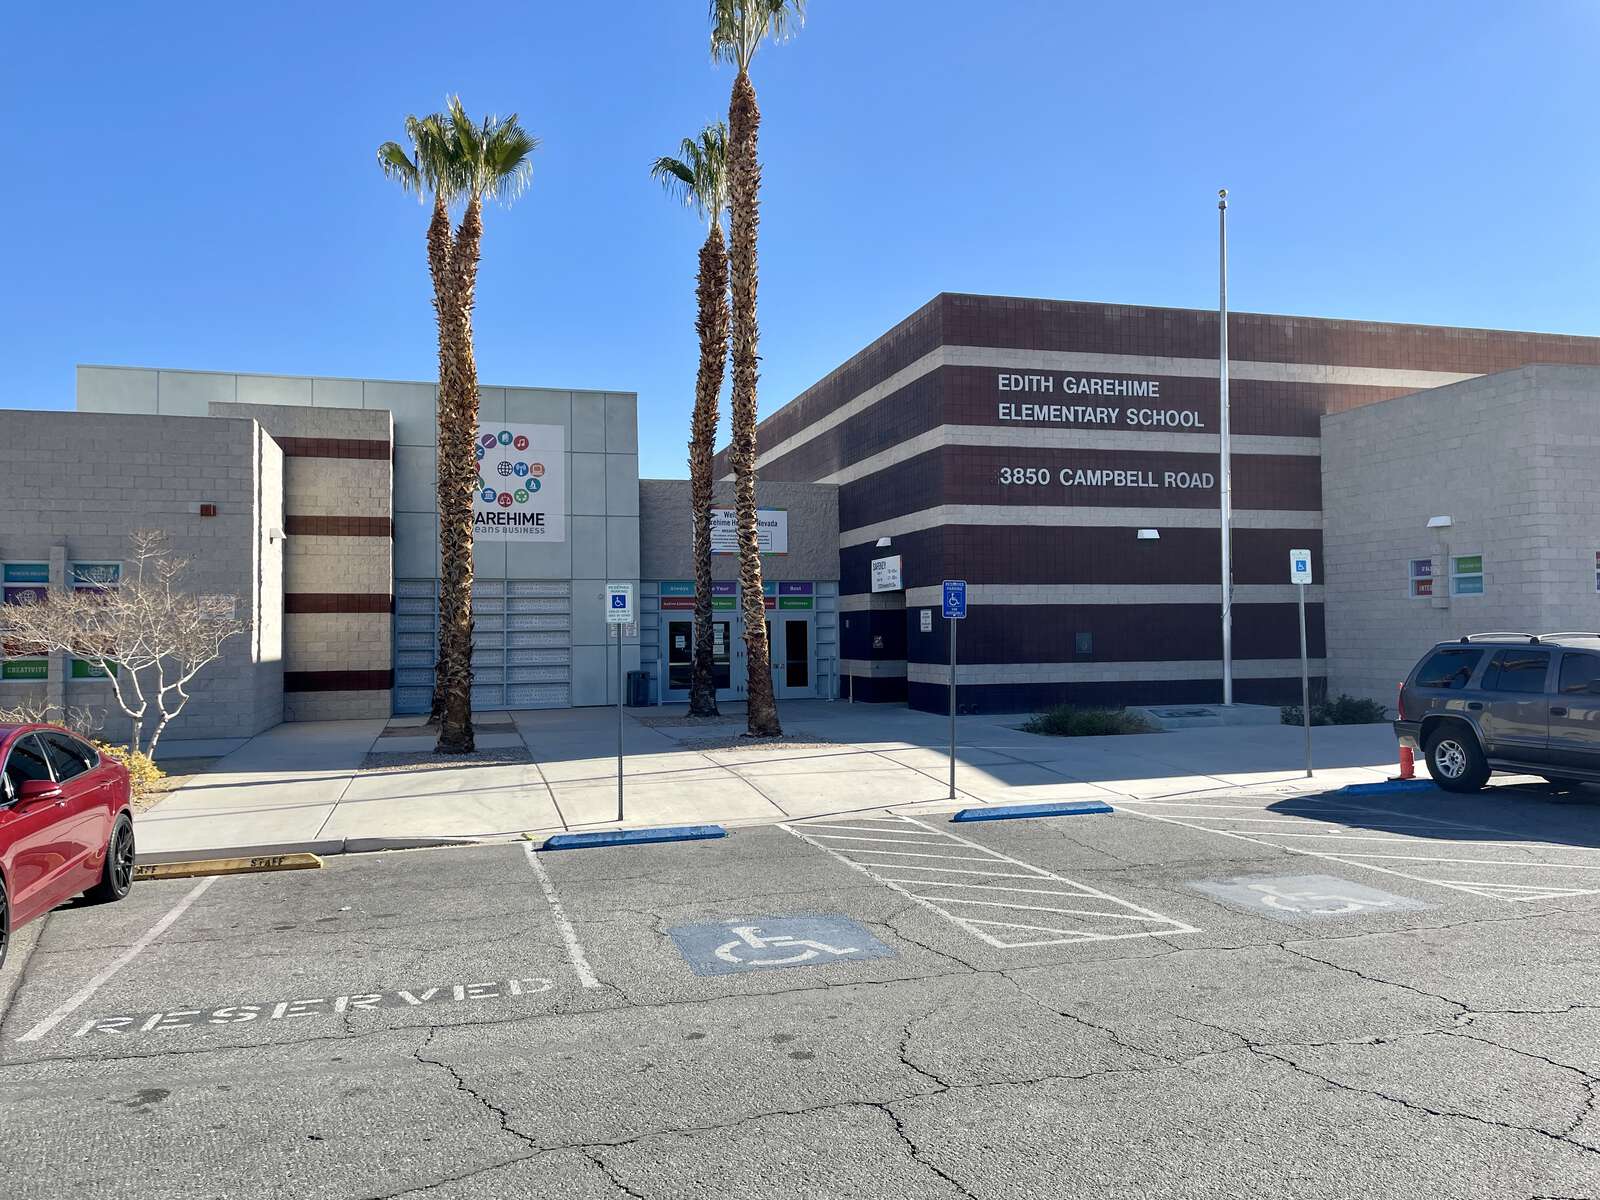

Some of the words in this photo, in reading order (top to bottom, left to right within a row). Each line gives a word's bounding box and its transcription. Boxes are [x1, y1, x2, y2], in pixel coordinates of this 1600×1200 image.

[998, 374, 1053, 393] EDITH
[1063, 377, 1160, 397] GAREHIME
[998, 403, 1120, 424] ELEMENTARY
[1126, 408, 1205, 428] SCHOOL
[1000, 467, 1050, 485] 3850
[1059, 469, 1159, 488] CAMPBELL
[1164, 472, 1215, 489] ROAD
[474, 511, 545, 526] AREHIME
[475, 526, 500, 534] eans
[502, 527, 545, 535] BUSINESS
[135, 865, 158, 875] AFF
[250, 856, 286, 867] STAFF
[72, 978, 552, 1038] RESERVED
